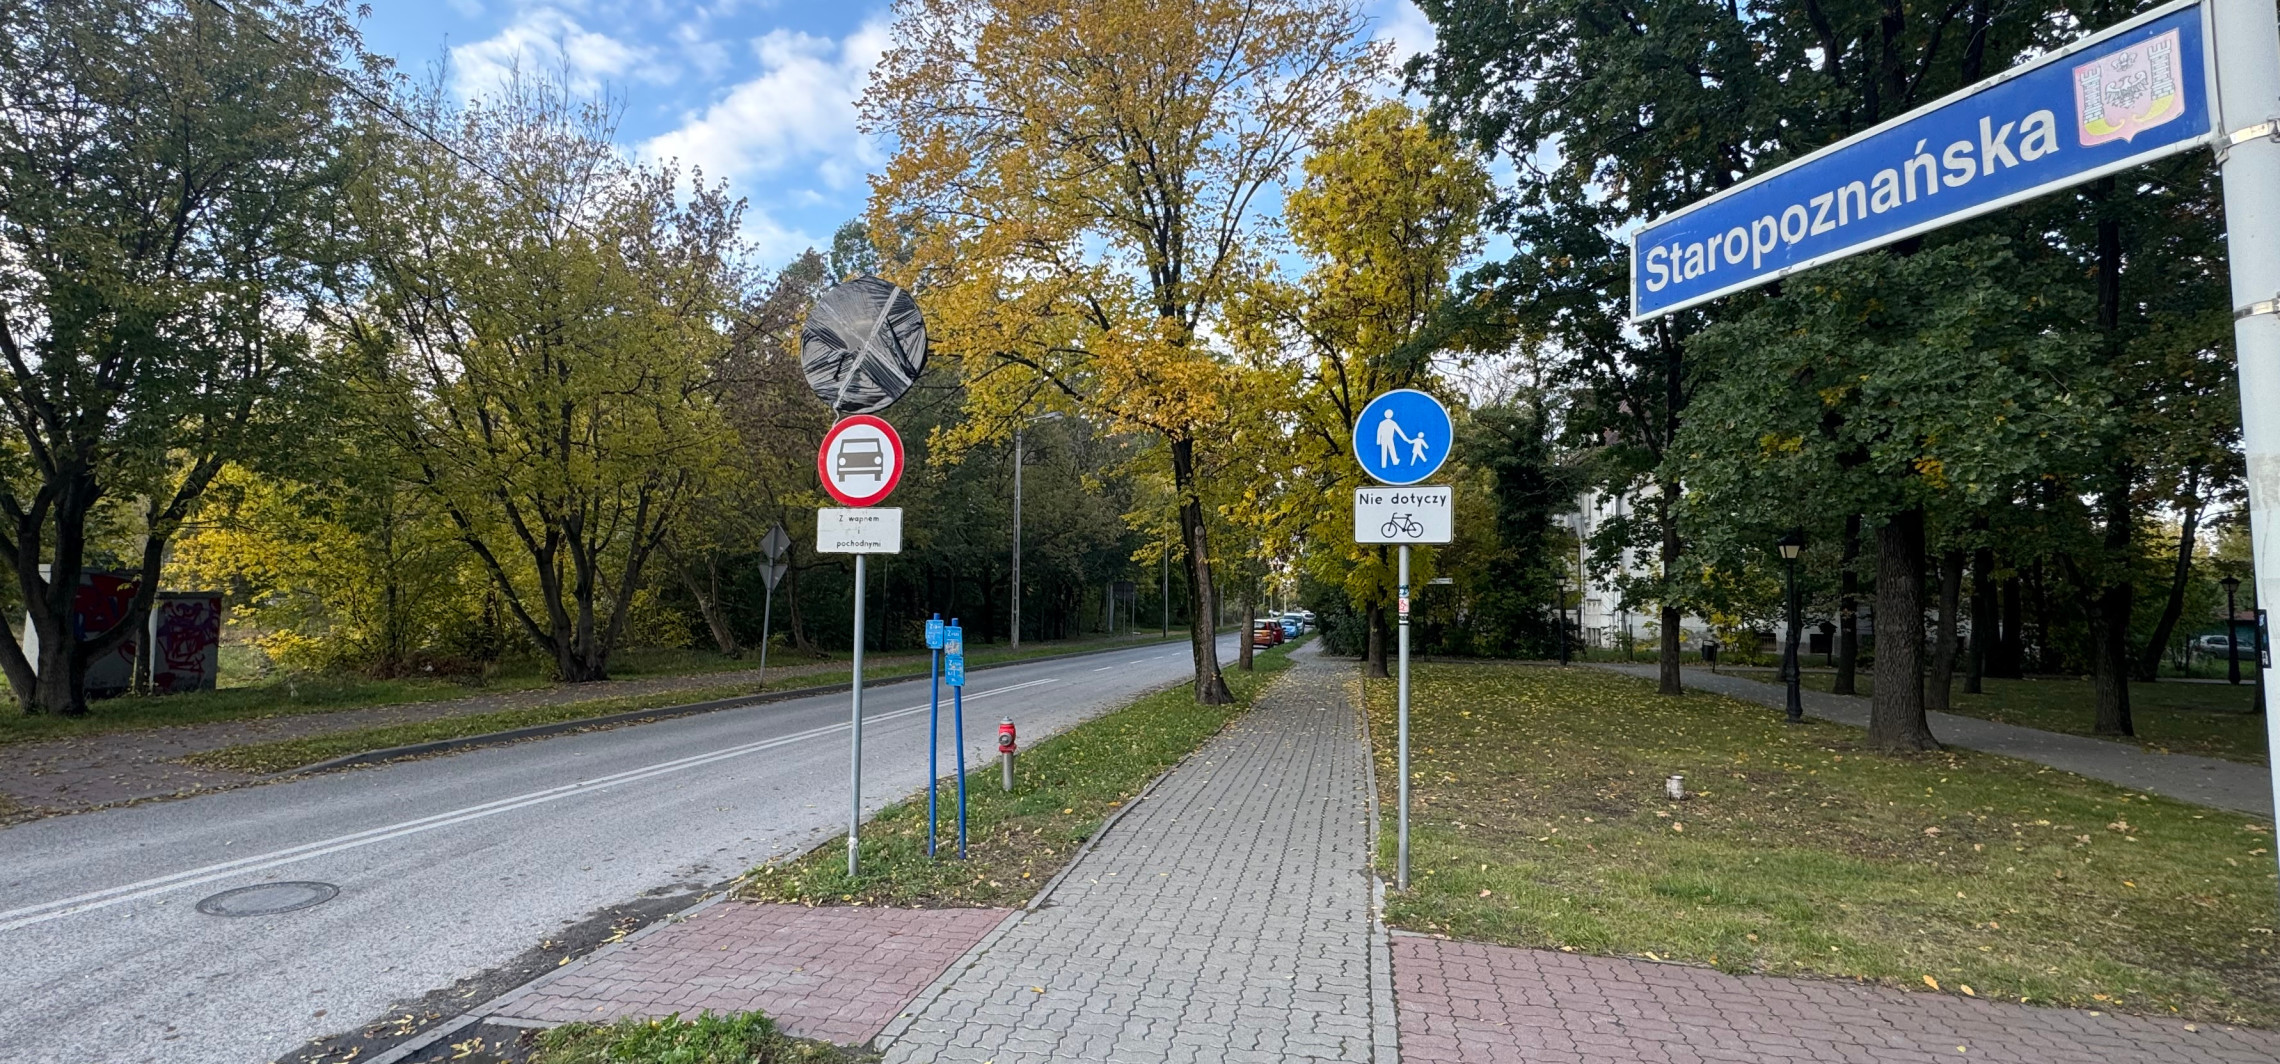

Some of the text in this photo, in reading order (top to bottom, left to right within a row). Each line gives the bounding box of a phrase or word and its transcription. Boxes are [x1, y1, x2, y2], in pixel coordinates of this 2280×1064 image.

[1645, 109, 2059, 293] Staropoznańska
[1359, 492, 1447, 507] Nie dotyczy
[848, 516, 880, 524] wapnem
[836, 540, 881, 549] pochodnymi
